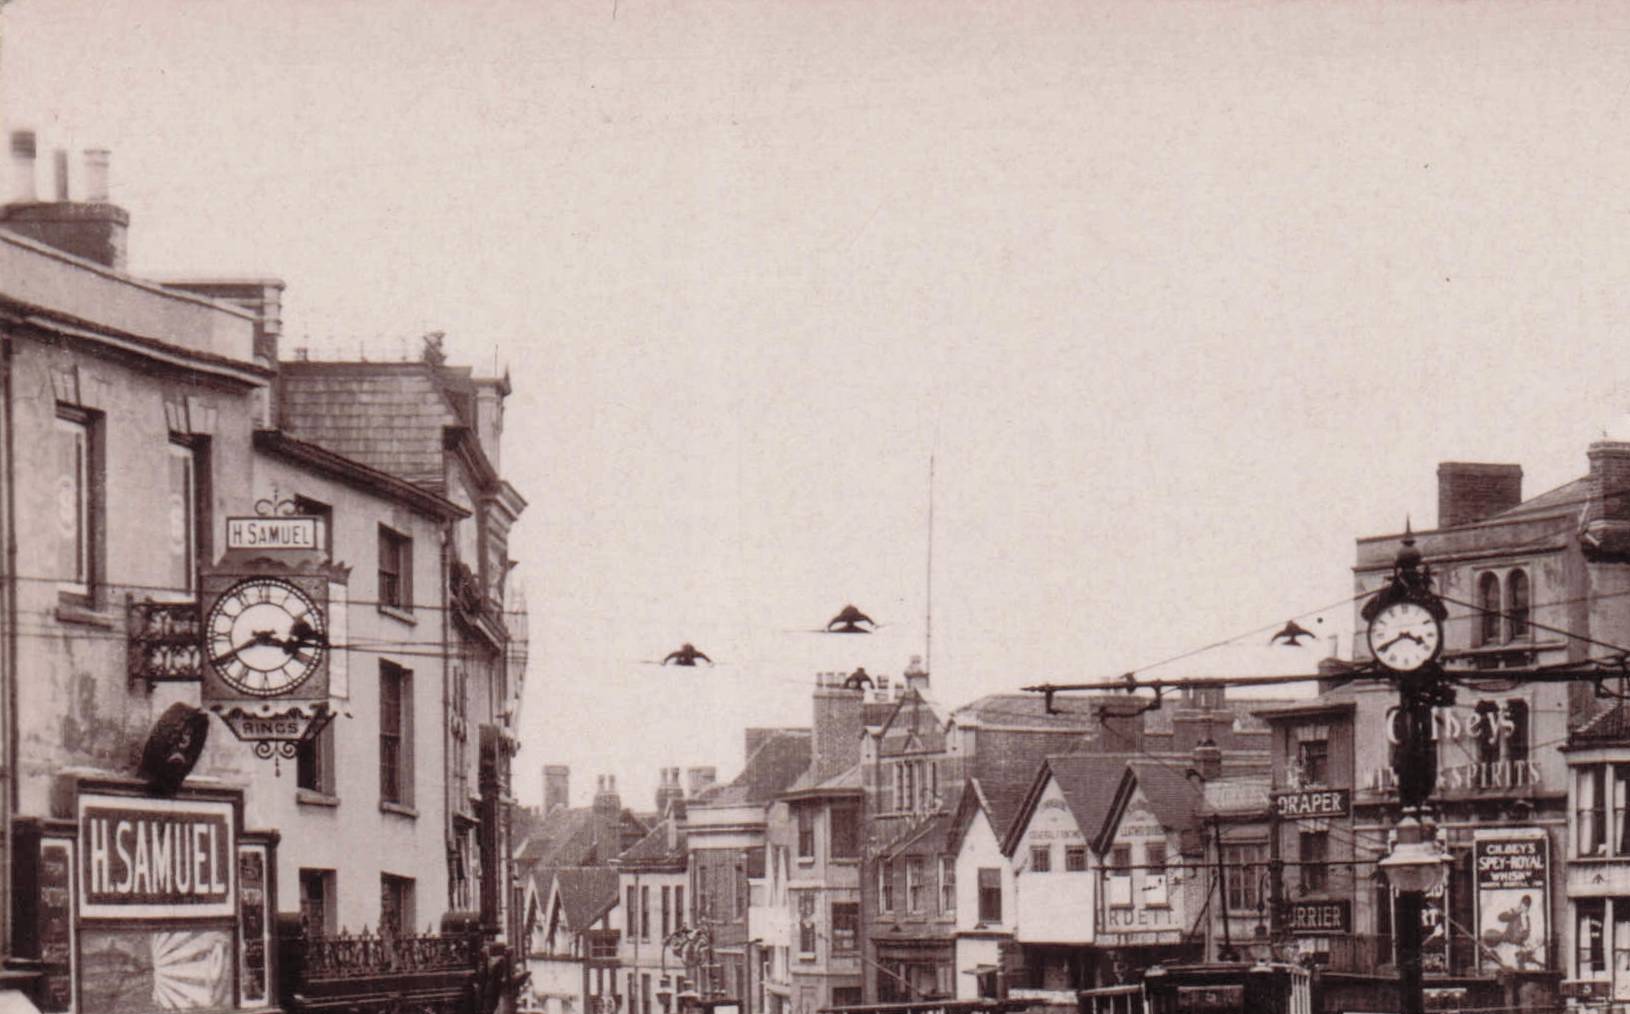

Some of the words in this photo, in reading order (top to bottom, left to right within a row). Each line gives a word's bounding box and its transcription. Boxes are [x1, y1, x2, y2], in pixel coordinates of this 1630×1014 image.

[232, 524, 242, 544] H
[249, 522, 311, 545] SAMUEL
[241, 721, 299, 736] RINGS
[1451, 760, 1541, 790] SPIRITS
[1278, 793, 1342, 815] DRAPER
